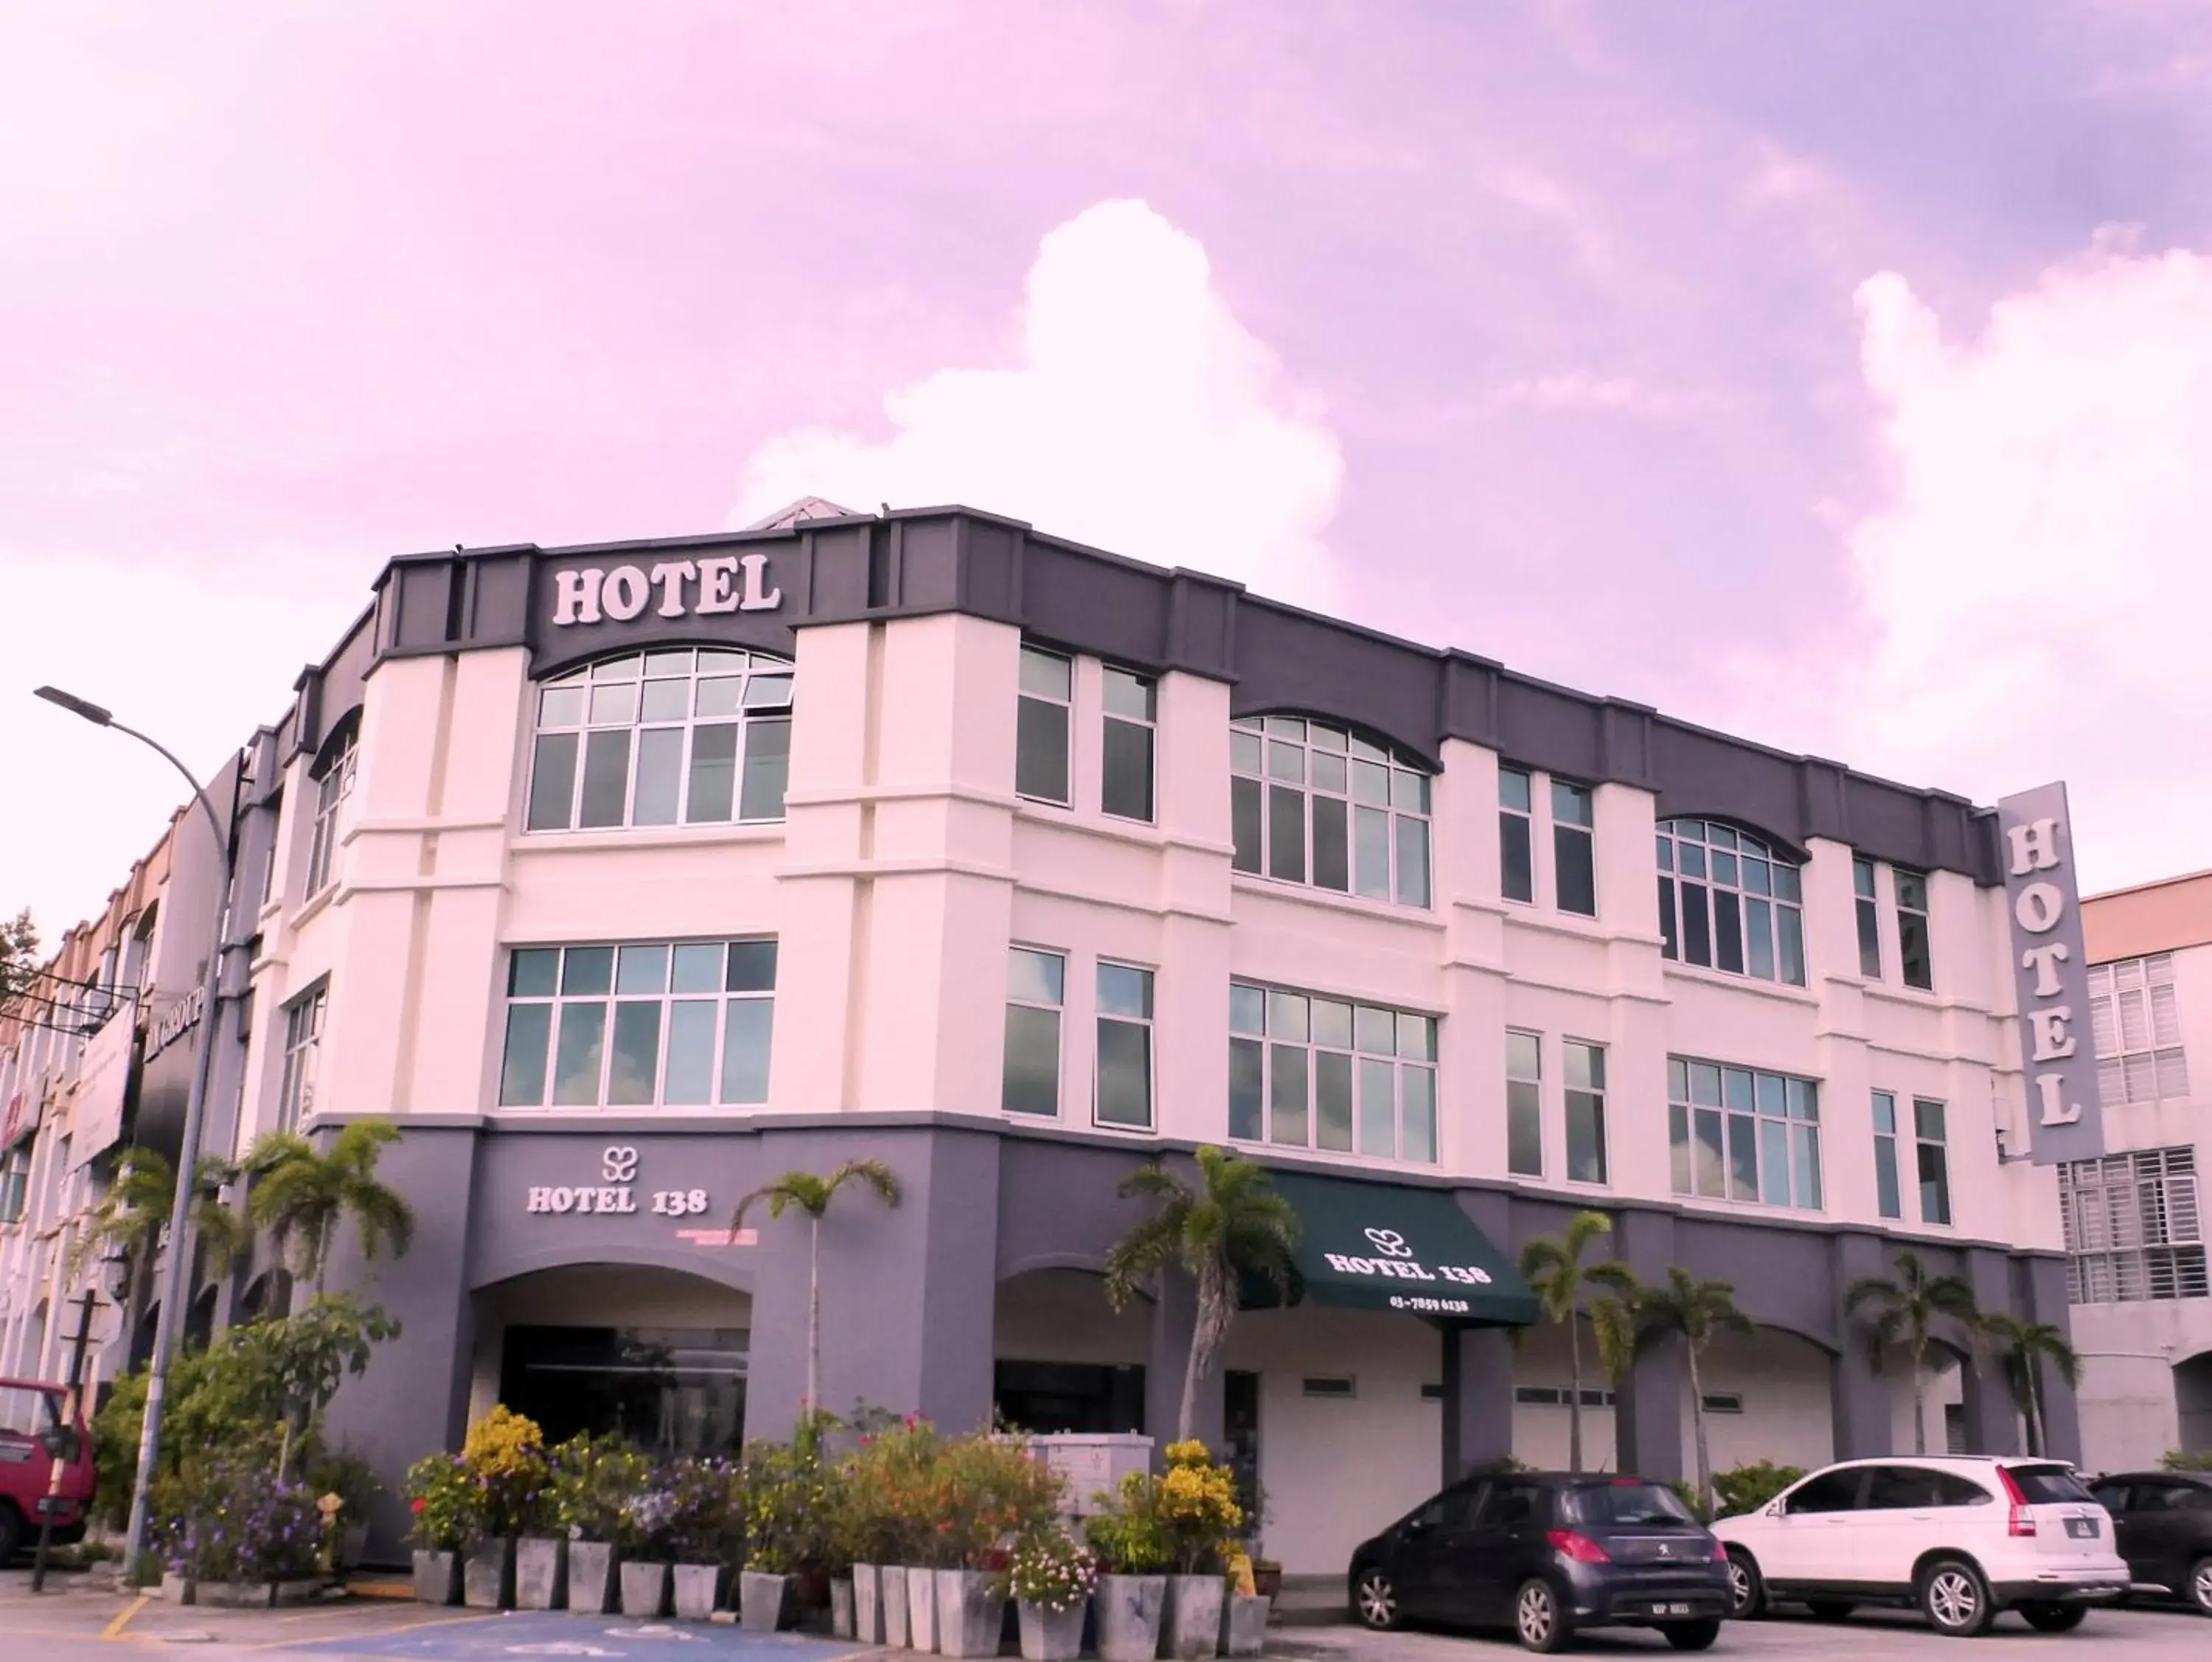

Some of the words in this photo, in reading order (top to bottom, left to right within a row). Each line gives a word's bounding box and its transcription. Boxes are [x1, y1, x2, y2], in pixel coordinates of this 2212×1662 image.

[553, 554, 781, 625] HOTEL
[2007, 818, 2081, 1126] HOTEL
[527, 1186, 636, 1213] HOTEL
[652, 1189, 708, 1216] 138
[1324, 1254, 1435, 1281] HOTEL
[1439, 1266, 1492, 1284] 138
